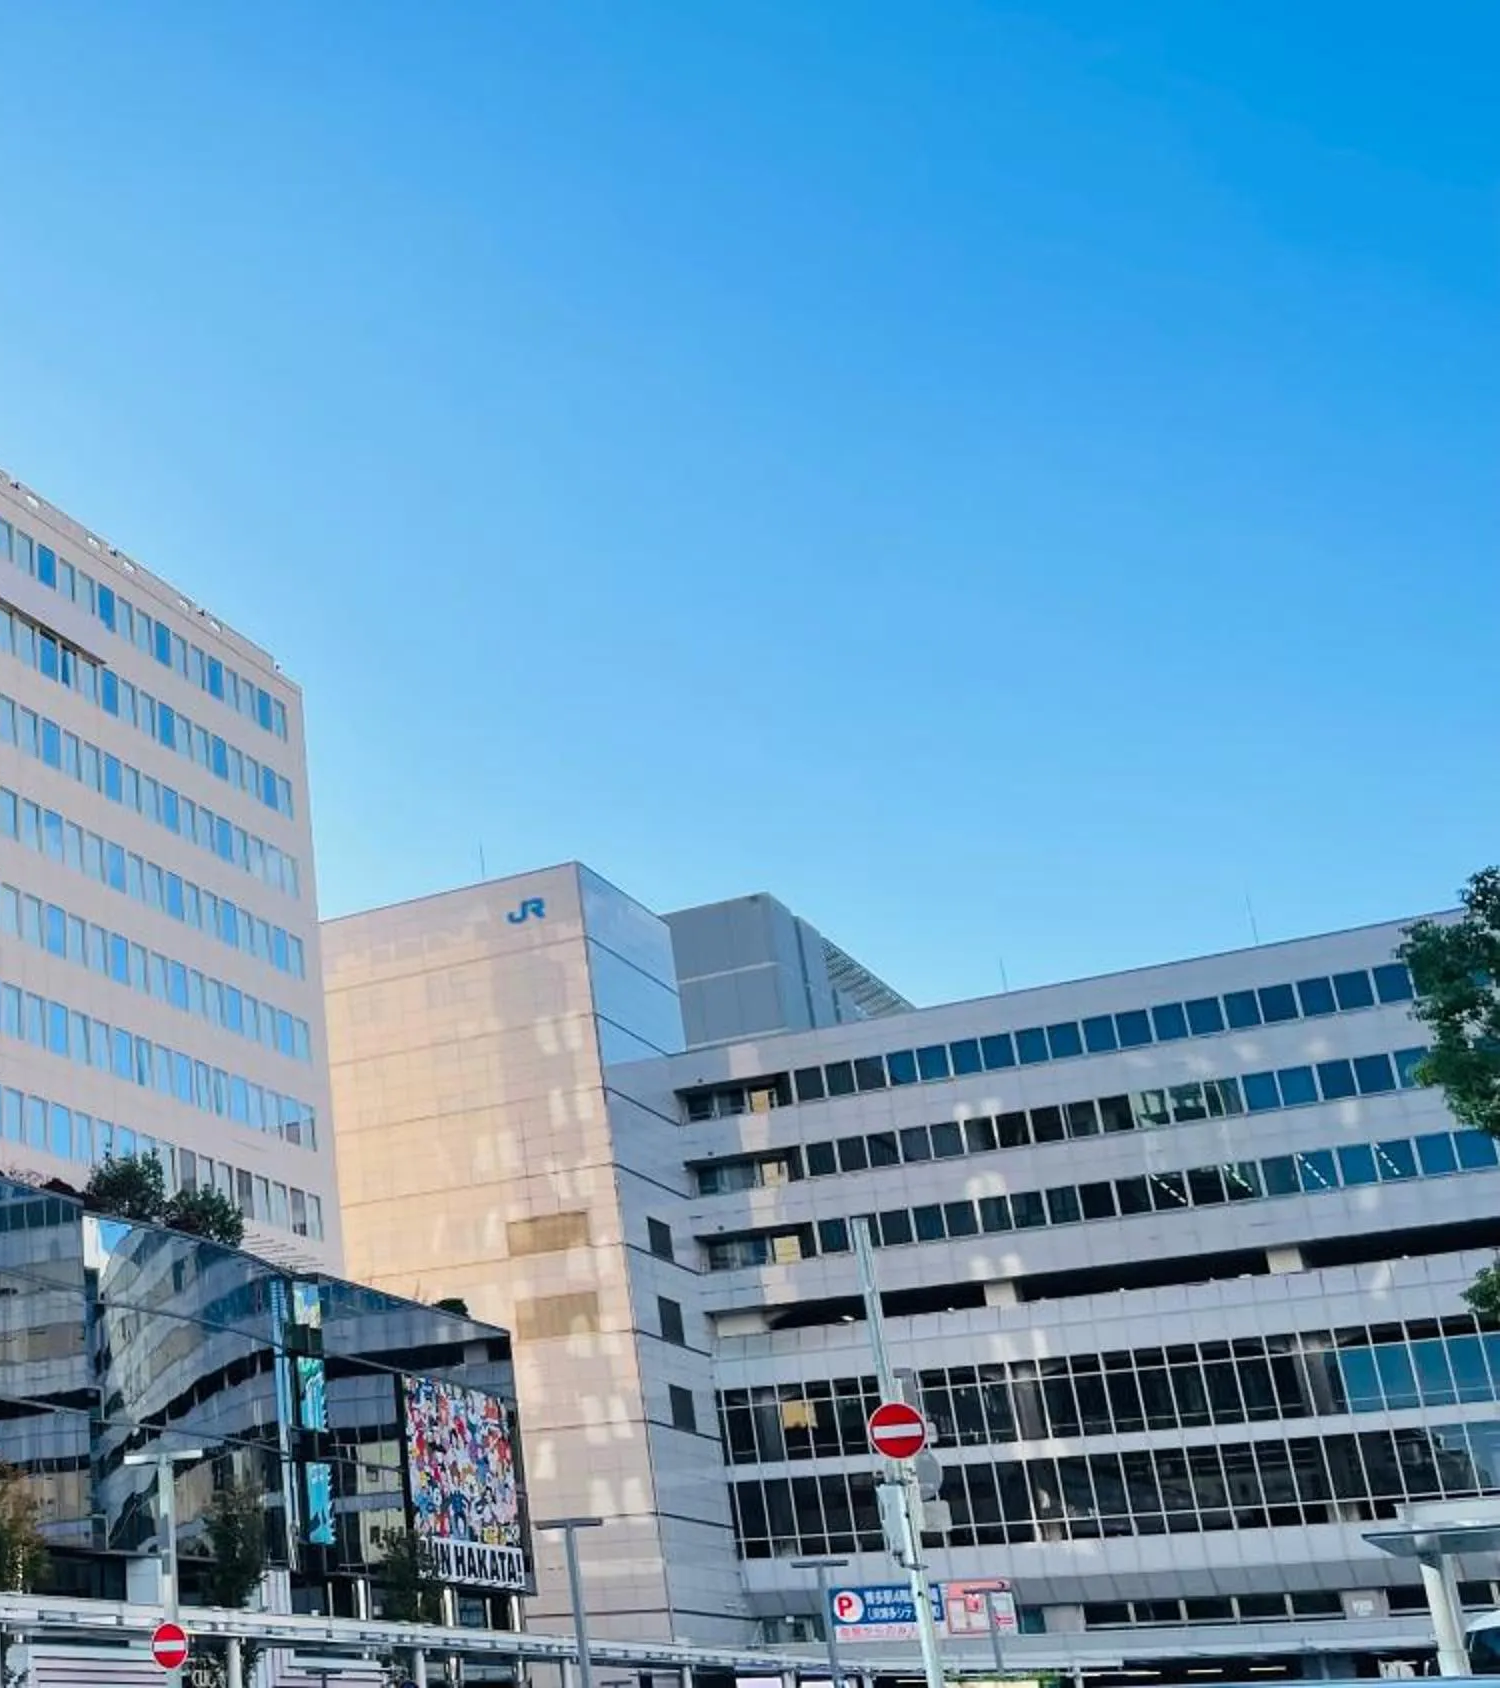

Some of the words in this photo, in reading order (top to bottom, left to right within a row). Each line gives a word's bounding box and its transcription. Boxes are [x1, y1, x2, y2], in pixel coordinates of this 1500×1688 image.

[507, 897, 546, 924] JR
[454, 1544, 523, 1584] HAKATA!
[837, 1596, 853, 1617] P
